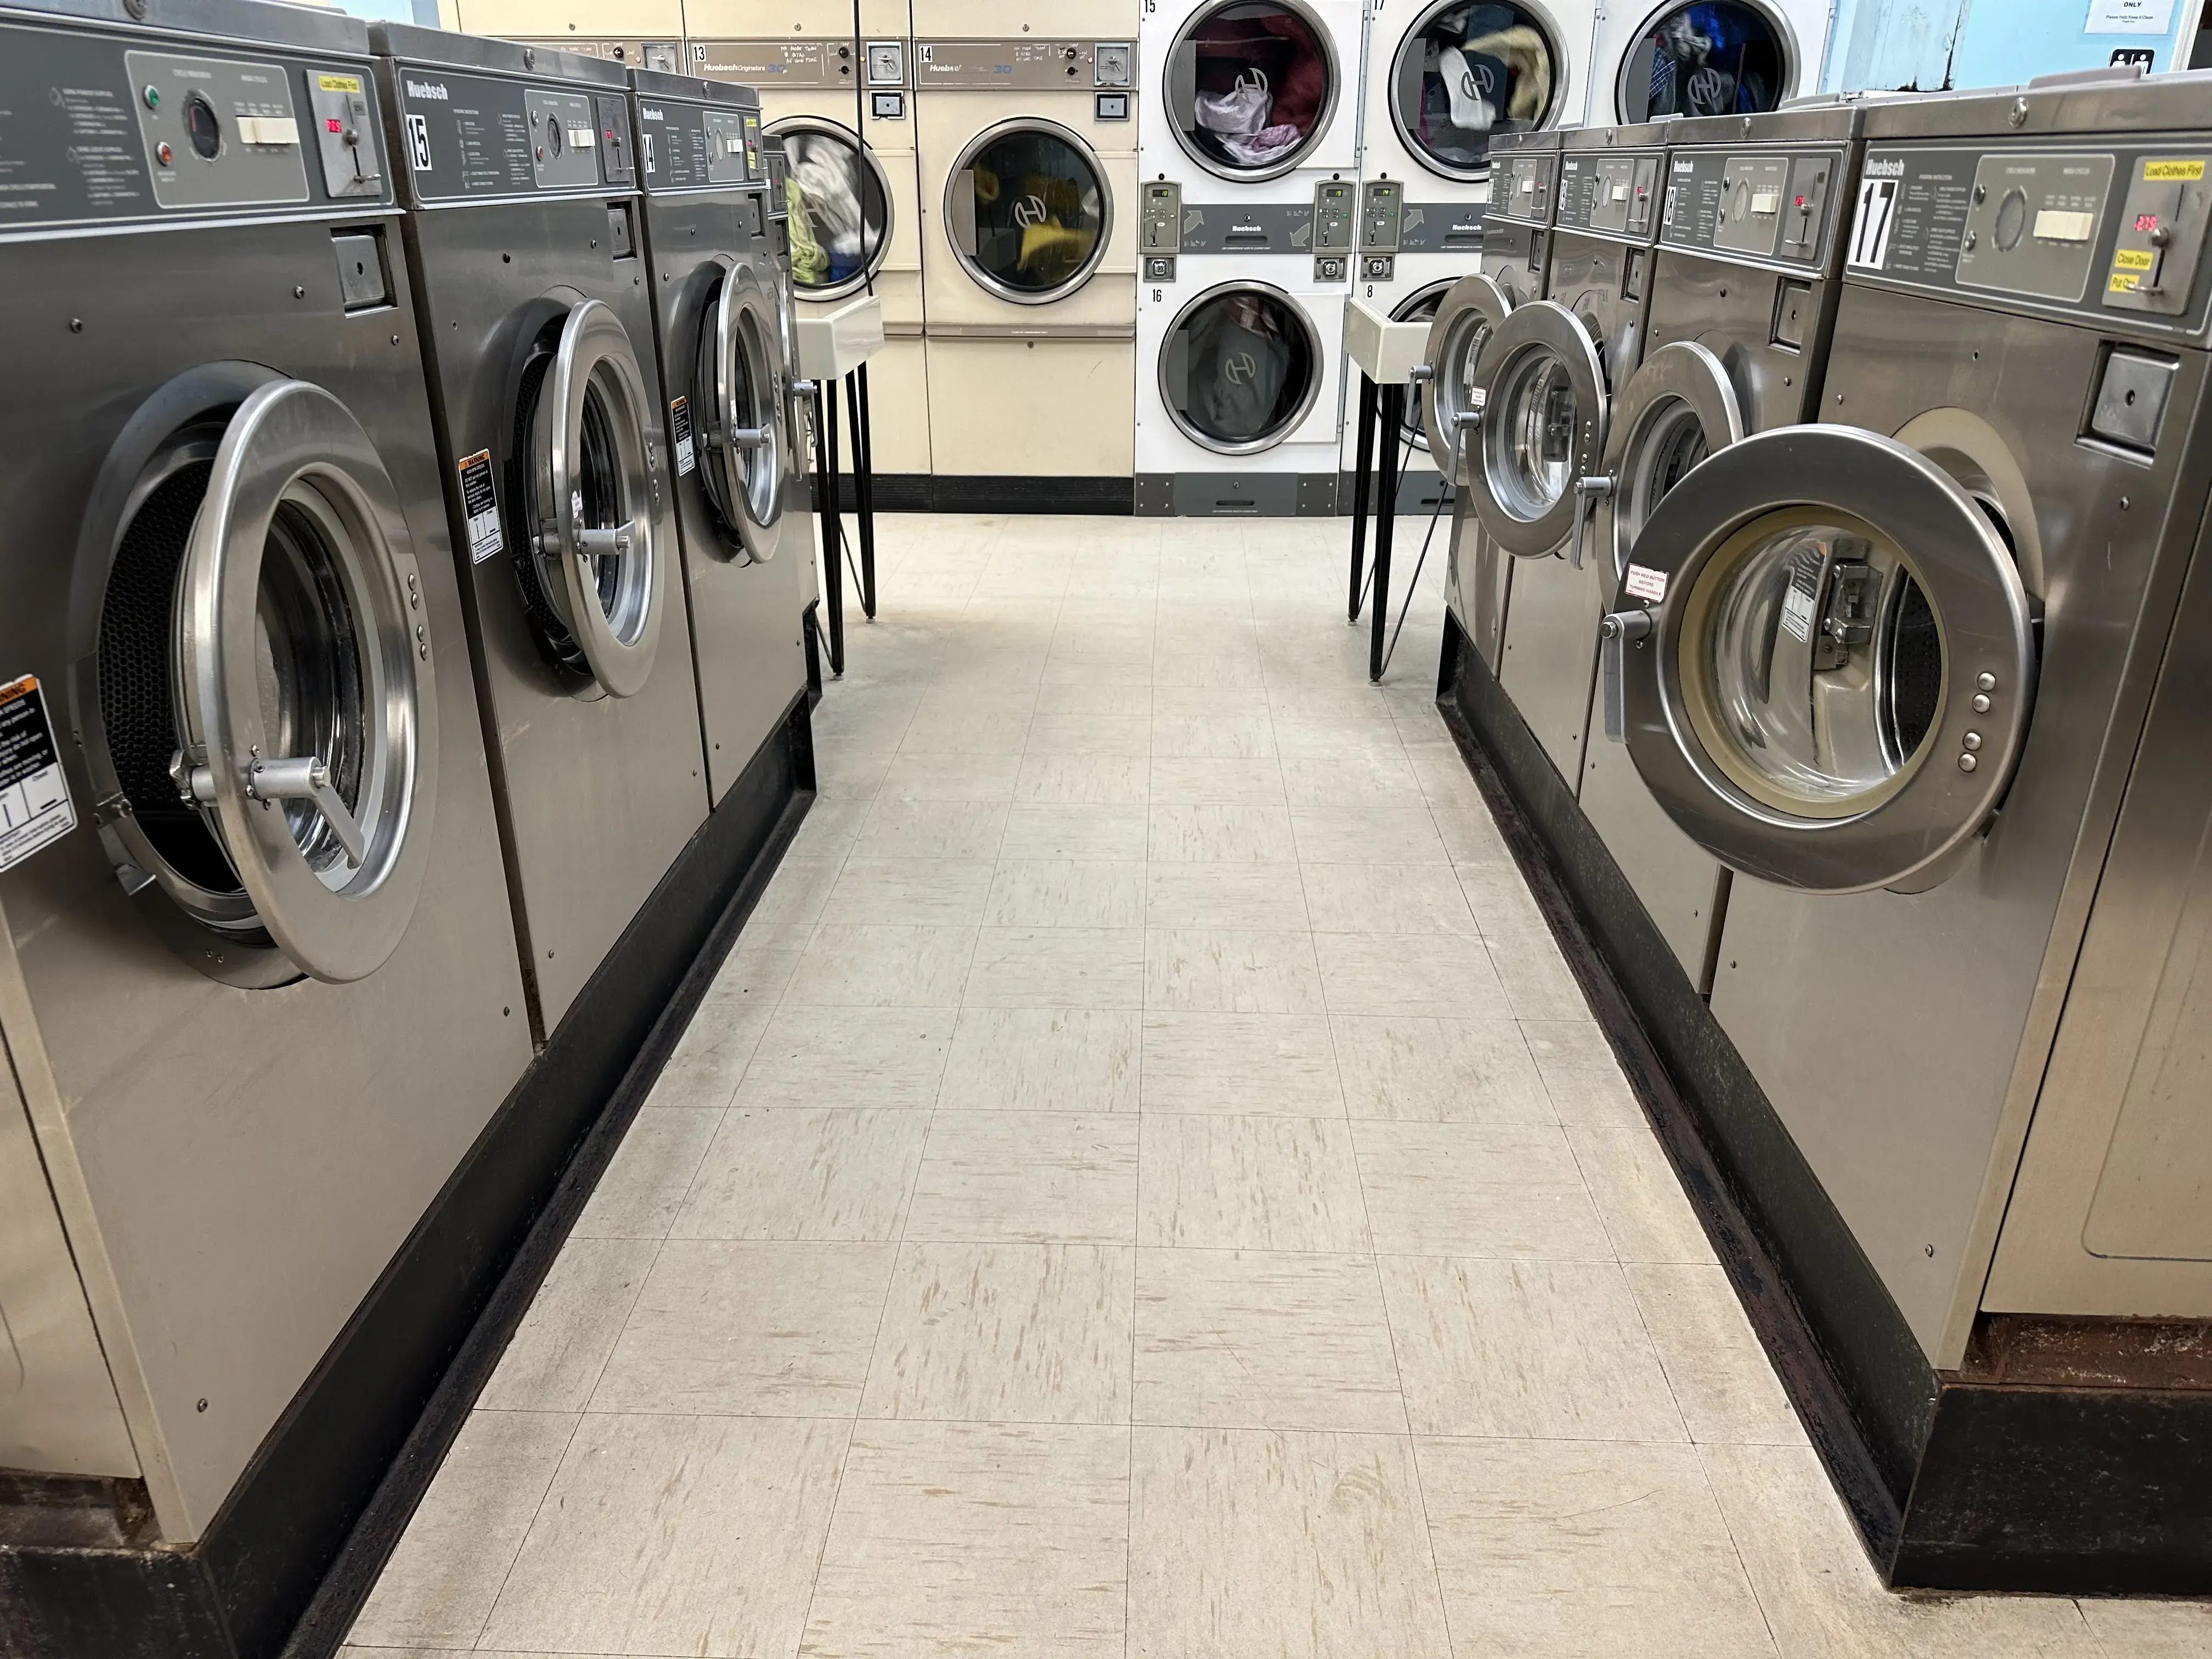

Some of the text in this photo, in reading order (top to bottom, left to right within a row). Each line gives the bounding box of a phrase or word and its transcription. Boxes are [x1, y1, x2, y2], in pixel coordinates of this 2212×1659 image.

[1145, 0, 1155, 13] 15
[694, 46, 705, 60] 13
[921, 47, 932, 61] 14
[407, 80, 448, 100] Huebsch
[642, 107, 664, 121] Huebsch
[409, 117, 428, 167] 15
[644, 136, 654, 171] 14
[1866, 158, 1905, 176] Huebsch
[2146, 165, 2203, 176] Load Clothes First
[1664, 189, 1674, 223] 18
[1855, 182, 1896, 263] 17
[2118, 253, 2149, 266] Close Door
[1153, 289, 1161, 302] 16
[1367, 285, 1373, 298] 8
